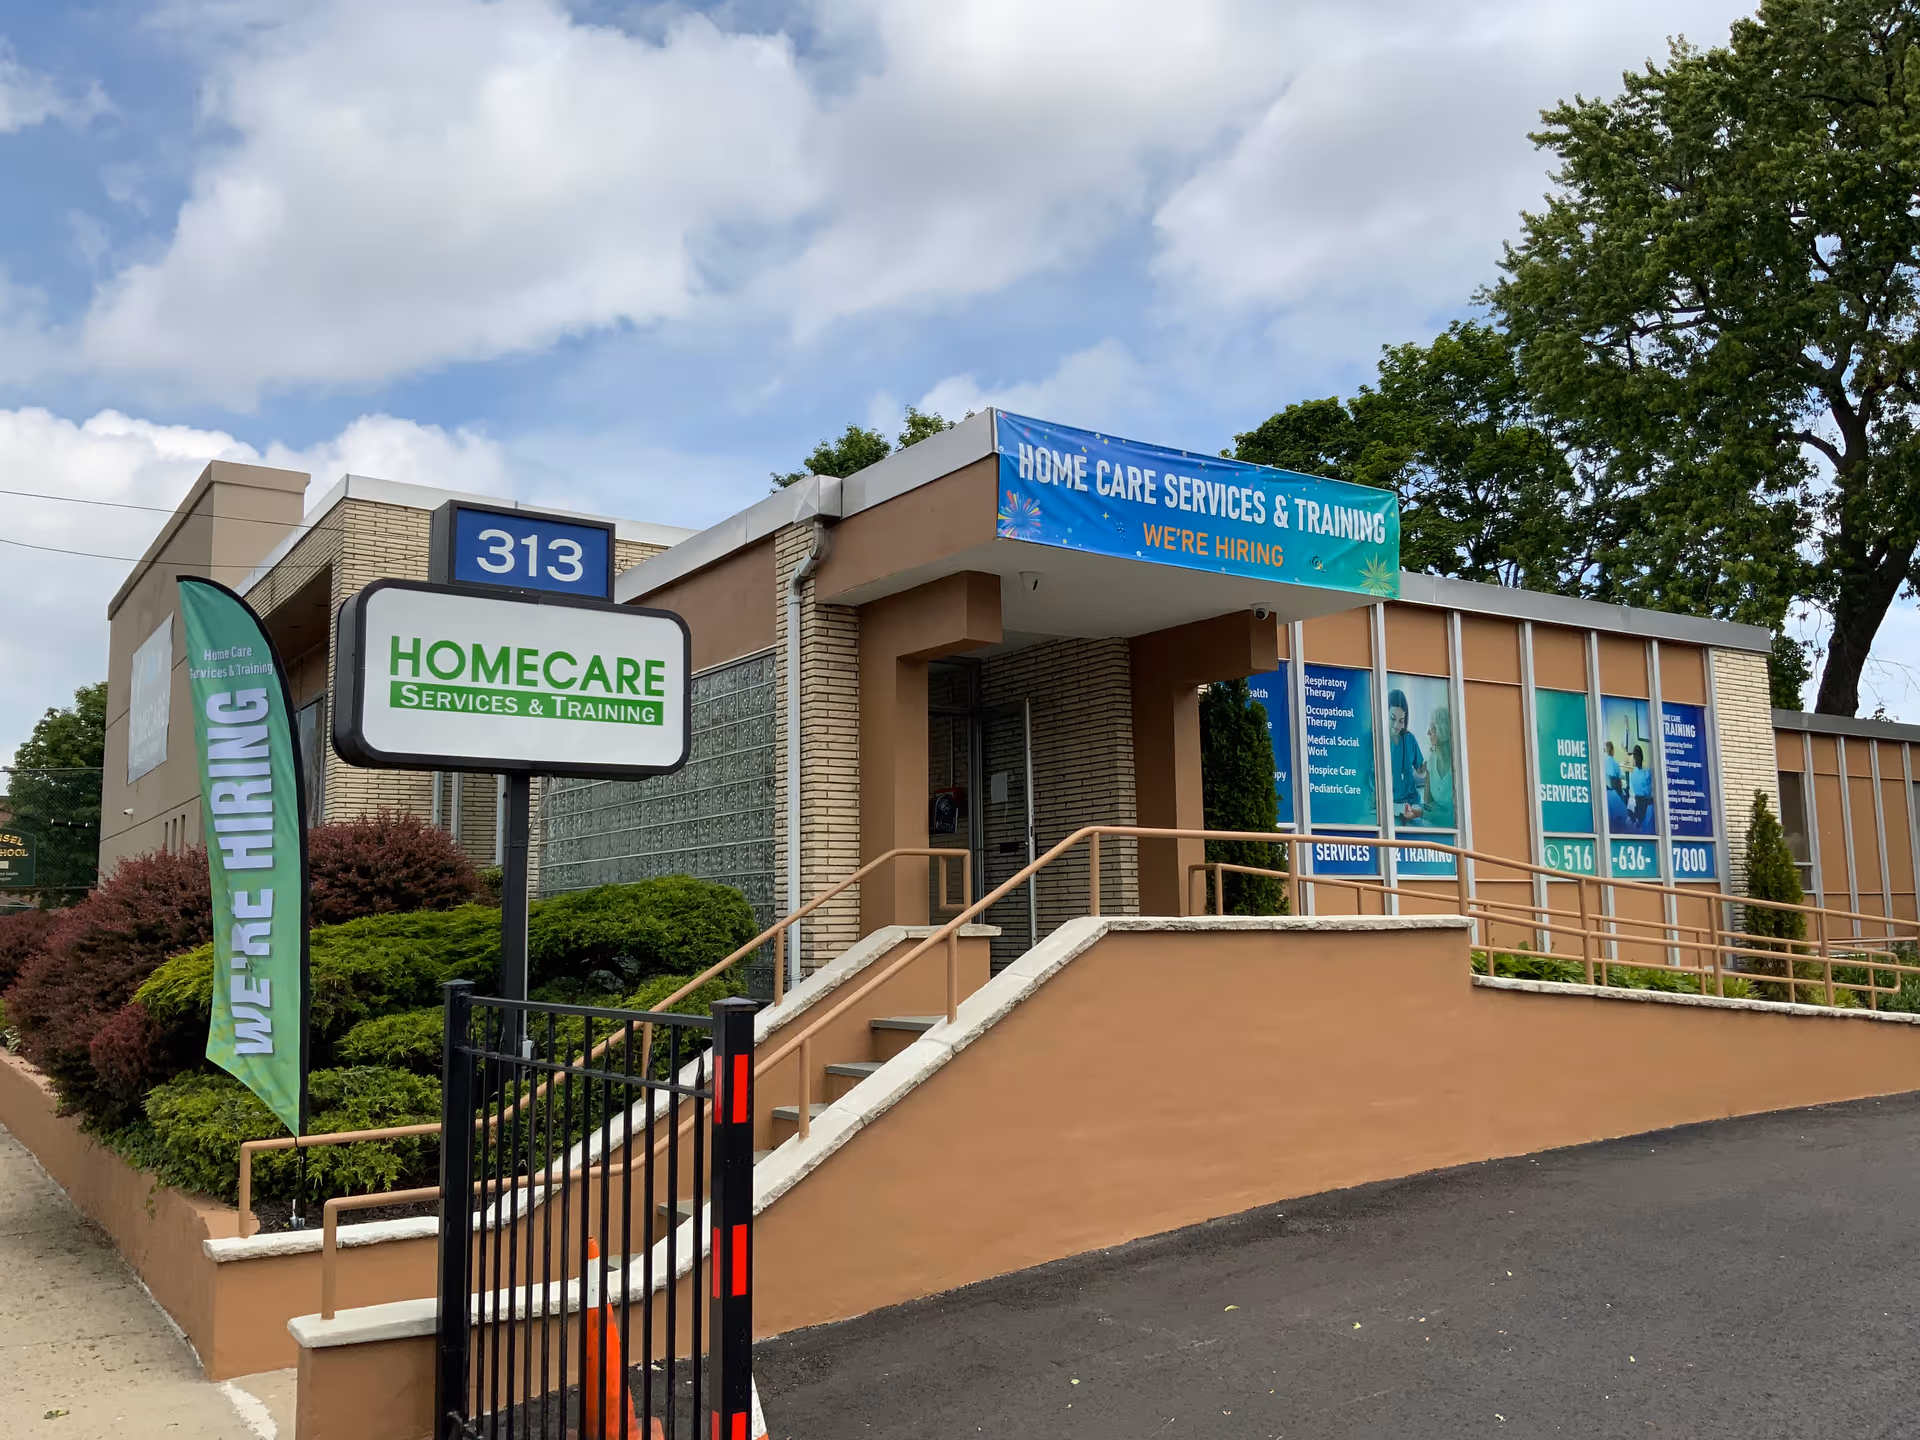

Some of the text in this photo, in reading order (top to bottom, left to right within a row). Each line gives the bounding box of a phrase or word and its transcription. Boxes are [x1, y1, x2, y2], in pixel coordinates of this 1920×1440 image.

[1019, 443, 1386, 544] HOME CARE SERVICES & TRAINING
[1143, 522, 1284, 568] WE'RE HIRING
[477, 529, 583, 582] 313
[204, 646, 252, 661] Home Care
[228, 665, 235, 677] &
[236, 662, 273, 675] Training
[390, 635, 666, 697] HOMECARE
[1304, 675, 1347, 690] Respiratory
[1249, 688, 1269, 699] ealth
[1305, 686, 1336, 700] Therapy
[400, 684, 655, 723] SERVICES & TRAINING
[1306, 704, 1354, 718] Occupational
[1306, 716, 1337, 730] Therapy
[1307, 734, 1360, 747] Medical Social
[1557, 739, 1587, 758] HOME
[1307, 746, 1328, 757] Work
[206, 687, 275, 870] HIRING
[1308, 764, 1357, 777] Hospice Care
[1560, 762, 1588, 781] CARE
[1309, 783, 1361, 795] Pediatric Care
[1540, 783, 1589, 803] SERVICES
[1316, 843, 1370, 862] SERVICES
[1563, 845, 1592, 871] 516
[1672, 847, 1707, 872] 7800
